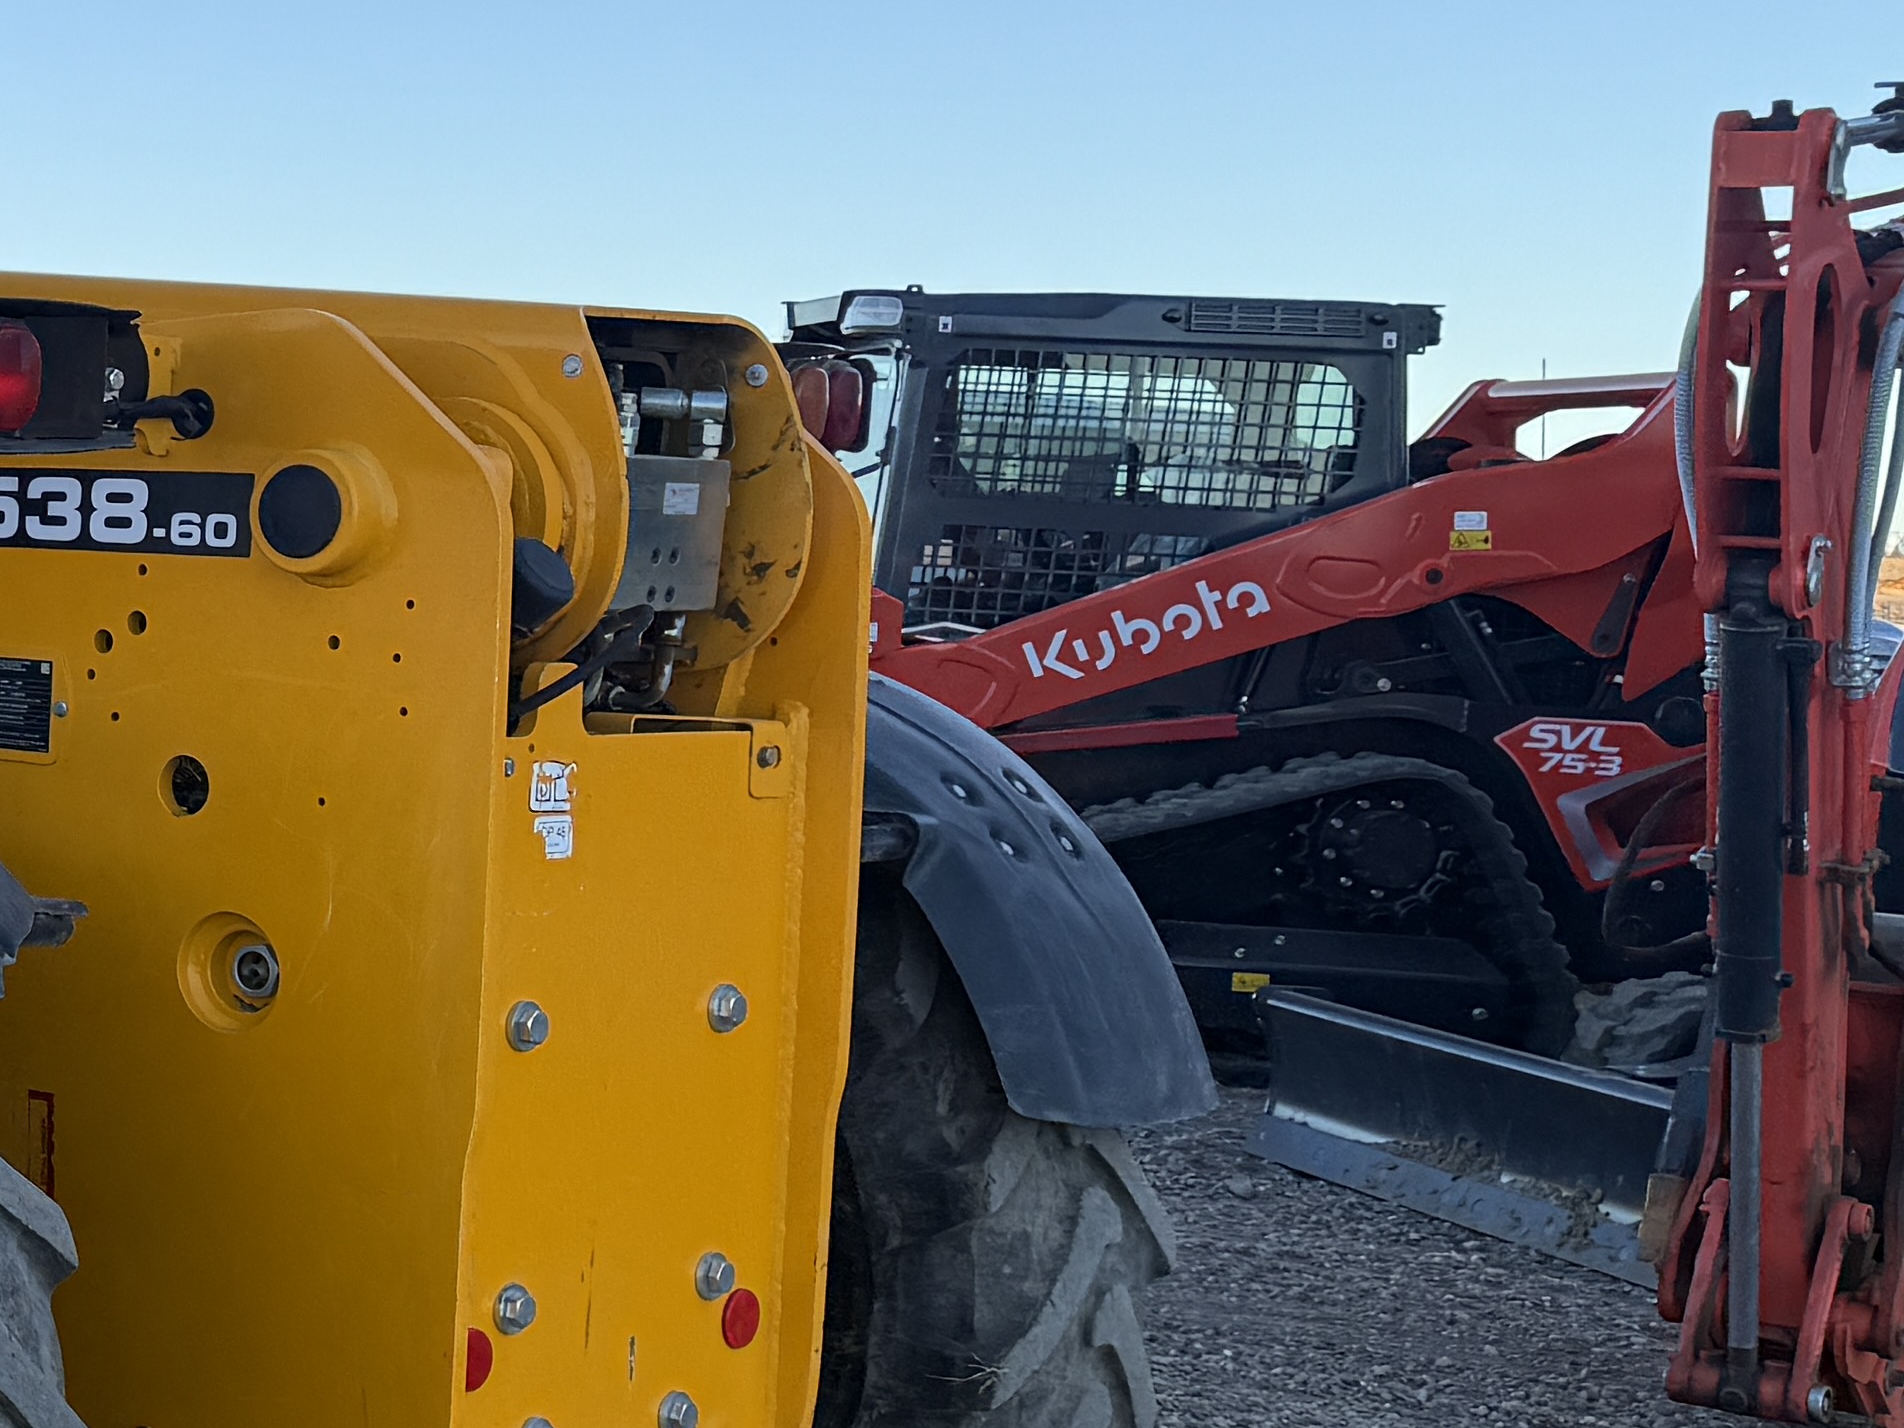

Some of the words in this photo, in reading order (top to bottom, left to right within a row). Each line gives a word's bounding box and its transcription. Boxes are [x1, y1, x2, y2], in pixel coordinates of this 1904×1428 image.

[1022, 580, 1271, 679] Kubota
[1522, 723, 1620, 753] SVL
[1538, 752, 1622, 777] 75-3
